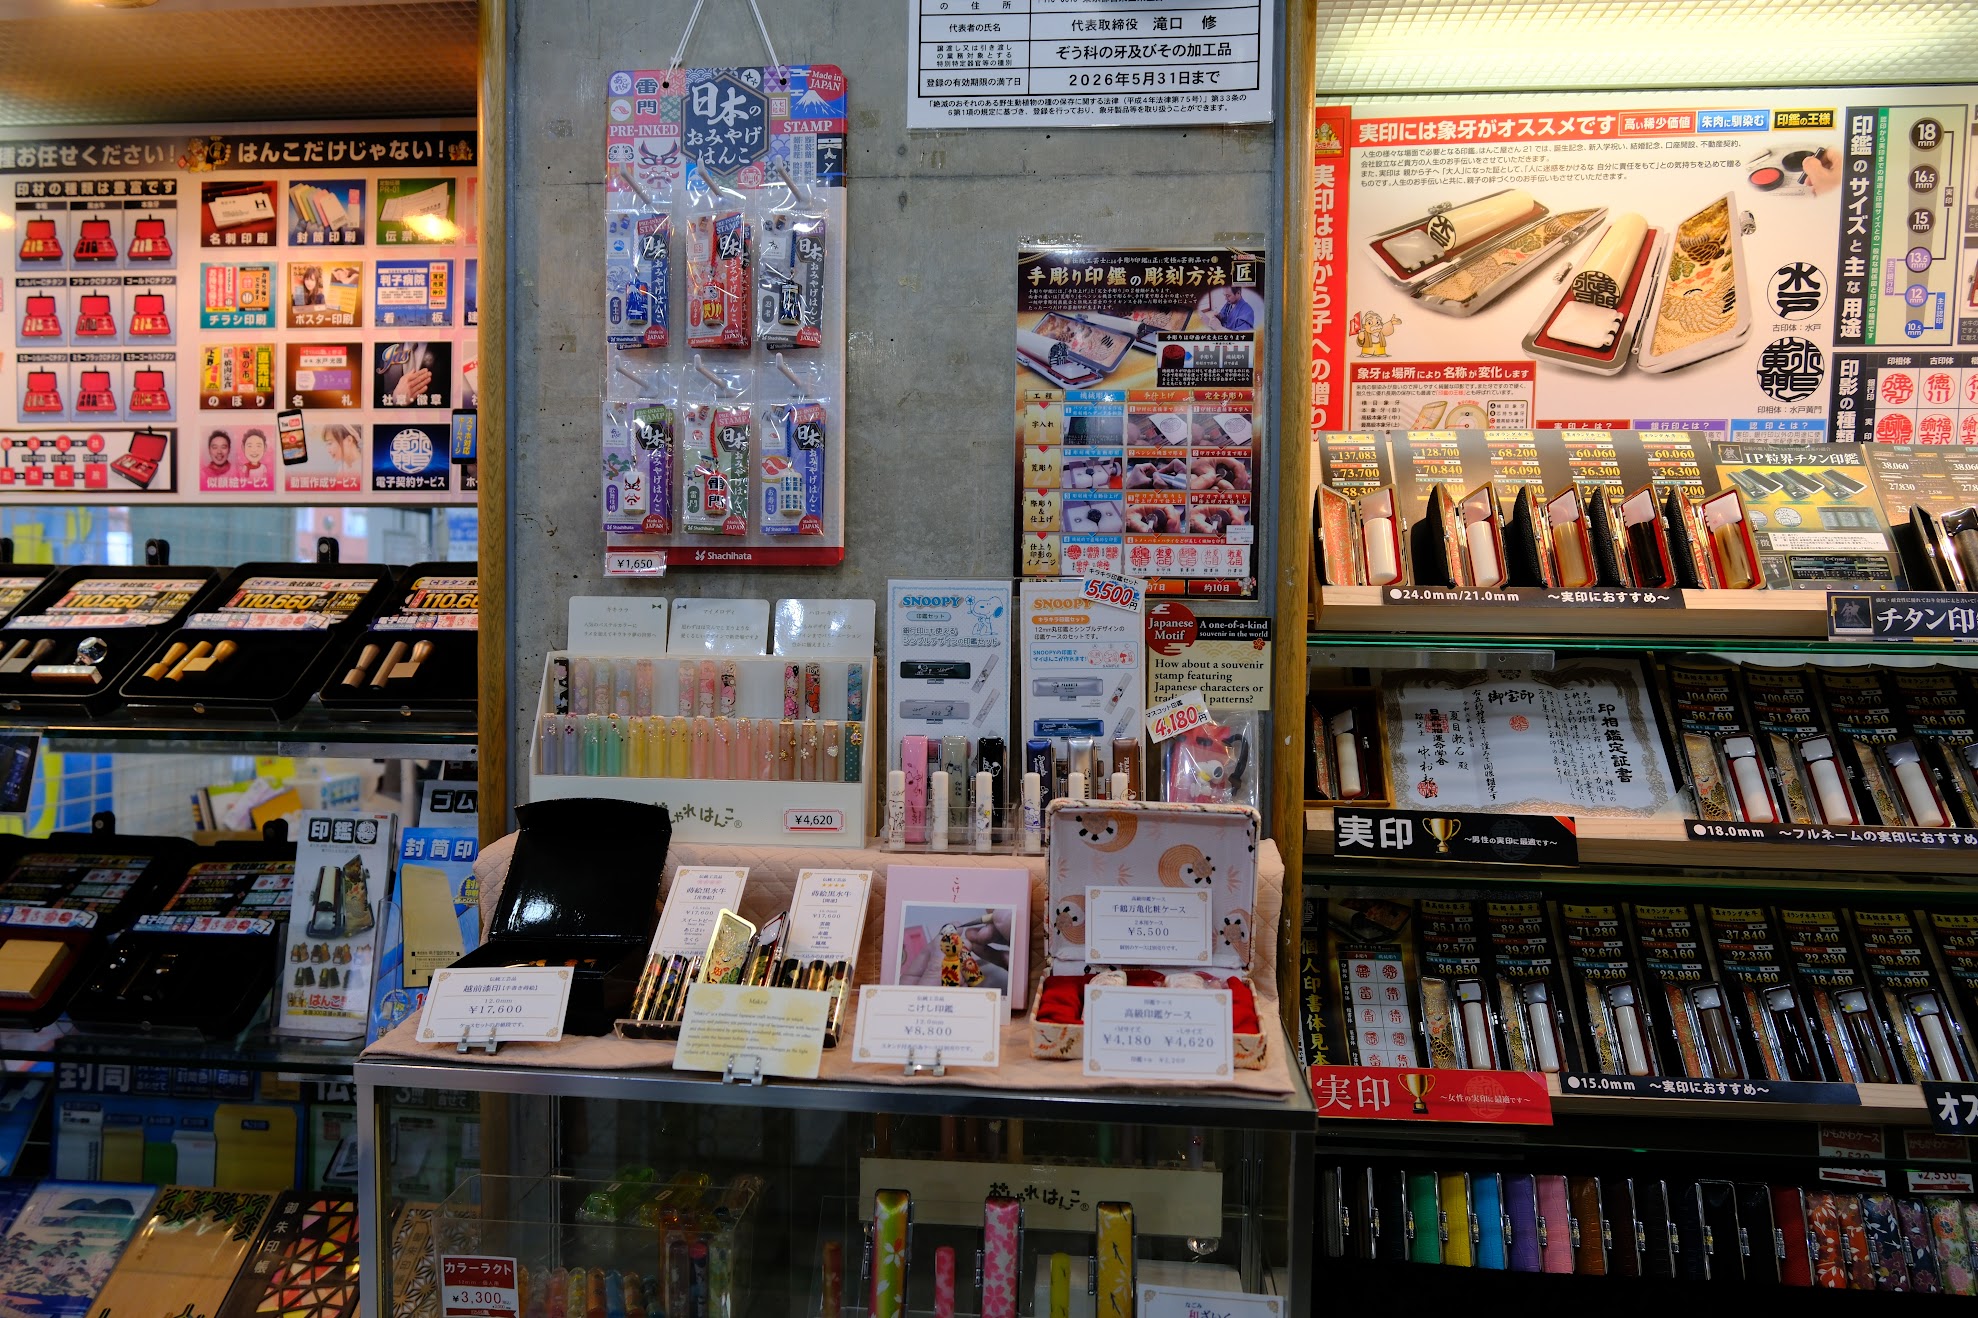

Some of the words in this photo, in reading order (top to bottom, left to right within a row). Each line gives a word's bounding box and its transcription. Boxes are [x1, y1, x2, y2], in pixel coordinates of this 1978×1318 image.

[949, 24, 1000, 33] 代表者の氏名
[1072, 18, 1139, 32] 代表取締役
[1153, 16, 1182, 30] 滝口
[1202, 15, 1217, 30] 修
[937, 44, 1012, 52] 譲渡し又は引き渡し
[1056, 42, 1232, 60] ぞう科の牙及びその加工品
[927, 78, 1021, 88] 登録の有効期限の満了日
[1069, 70, 1220, 87] 2026年5月31日まで
[809, 79, 841, 92] JAPAN
[636, 78, 659, 114] 雷門
[1624, 115, 1691, 131] 高い稀少価値
[1701, 114, 1765, 128] 朱肉に馴染む
[1777, 112, 1832, 127] 印鑑の王様
[610, 125, 678, 137] PRE-INKED
[783, 120, 832, 133] STAMP
[1359, 115, 1616, 144] 実印には象牙がオススメです
[1917, 124, 1936, 140] 18
[687, 126, 763, 145] おみやげ
[238, 140, 445, 163] はんこだけじゃない!
[697, 149, 751, 165] はんこ
[1361, 155, 1550, 168] 会社設立など貴方の人生のお手伝いをさせていただきます。
[17, 180, 175, 196] 印材の種類は豊富です
[1841, 115, 1873, 338] 印鑑のサイズと主な用途
[210, 232, 268, 245] 名刺印刷
[297, 231, 356, 244] 封筒印刷
[380, 274, 425, 286] 判子病院
[1027, 265, 1226, 287] 手彫り印鑑の彫刻方法
[210, 313, 267, 326] チラシ印刷
[296, 313, 353, 325] ポスター印刷
[384, 312, 443, 323] 看板
[1772, 324, 1821, 332] 古印体:水戸
[1887, 357, 1912, 365] 印相体
[1929, 357, 1954, 365] 古印体
[1358, 367, 1528, 380] 象牙は場所により名称が変化します
[209, 395, 265, 407] のぼり
[1144, 392, 1175, 400] 手仕上げ
[1205, 392, 1243, 400] 完全手彫り
[1757, 405, 1822, 414] 印相体:水戸黄門
[1743, 453, 1861, 465] IP粒界チタン印鑑
[207, 477, 268, 488] 似顔絵サービス
[290, 476, 358, 488] 動画作成サービス
[376, 476, 445, 488] 電子契約サービス
[707, 551, 752, 561] Shachihata
[618, 559, 653, 569] ¥1,650
[1204, 584, 1229, 592] 約10日
[902, 597, 960, 607] SNOOPY
[1403, 588, 1520, 603] 24.0mm/21.0mm
[1148, 618, 1194, 629] Japanese
[1209, 620, 1268, 629] one-of-a-kind
[1877, 607, 1978, 633] チタン印
[1155, 630, 1185, 640] Motif
[1155, 659, 1179, 668] How
[1182, 659, 1210, 669] about
[1222, 661, 1264, 669] souvenir
[1155, 672, 1184, 682] stamp
[1187, 671, 1232, 683] featuring
[1154, 682, 1197, 692] Japanese
[1200, 683, 1249, 692] characters
[1146, 700, 1183, 718] マスコット印鑑
[1598, 704, 1632, 782] 印相鑑定証書
[433, 792, 474, 810] ゴム
[795, 814, 833, 826] ¥4,620
[311, 820, 355, 841] 印鑑
[1338, 815, 1413, 850] 実印
[1706, 825, 1765, 838] 18.0mm
[405, 838, 473, 858] 封筒印
[1112, 904, 1186, 915] 千鶴万亀化粧ケース
[1640, 907, 1681, 915] 白オランダ水牛
[1715, 909, 1757, 917] 黒オランダ水牛
[1127, 927, 1169, 937] ¥5,500
[468, 1005, 522, 1014] ¥17,600
[907, 1004, 953, 1013] こけし印鑑
[1124, 1009, 1192, 1020] 高級印鑑ケース
[904, 1026, 952, 1036] ¥8,800
[1103, 1034, 1152, 1046] ¥4,180
[1164, 1036, 1214, 1048] ¥4,620
[1581, 1077, 1636, 1091] 15.0mm
[1316, 1074, 1391, 1111] 実印
[1823, 1128, 1880, 1143] かもがわケース
[253, 1202, 299, 1275] 御朱印帳
[445, 1262, 511, 1275] カラーラクト
[453, 1291, 501, 1304] ¥3,300
